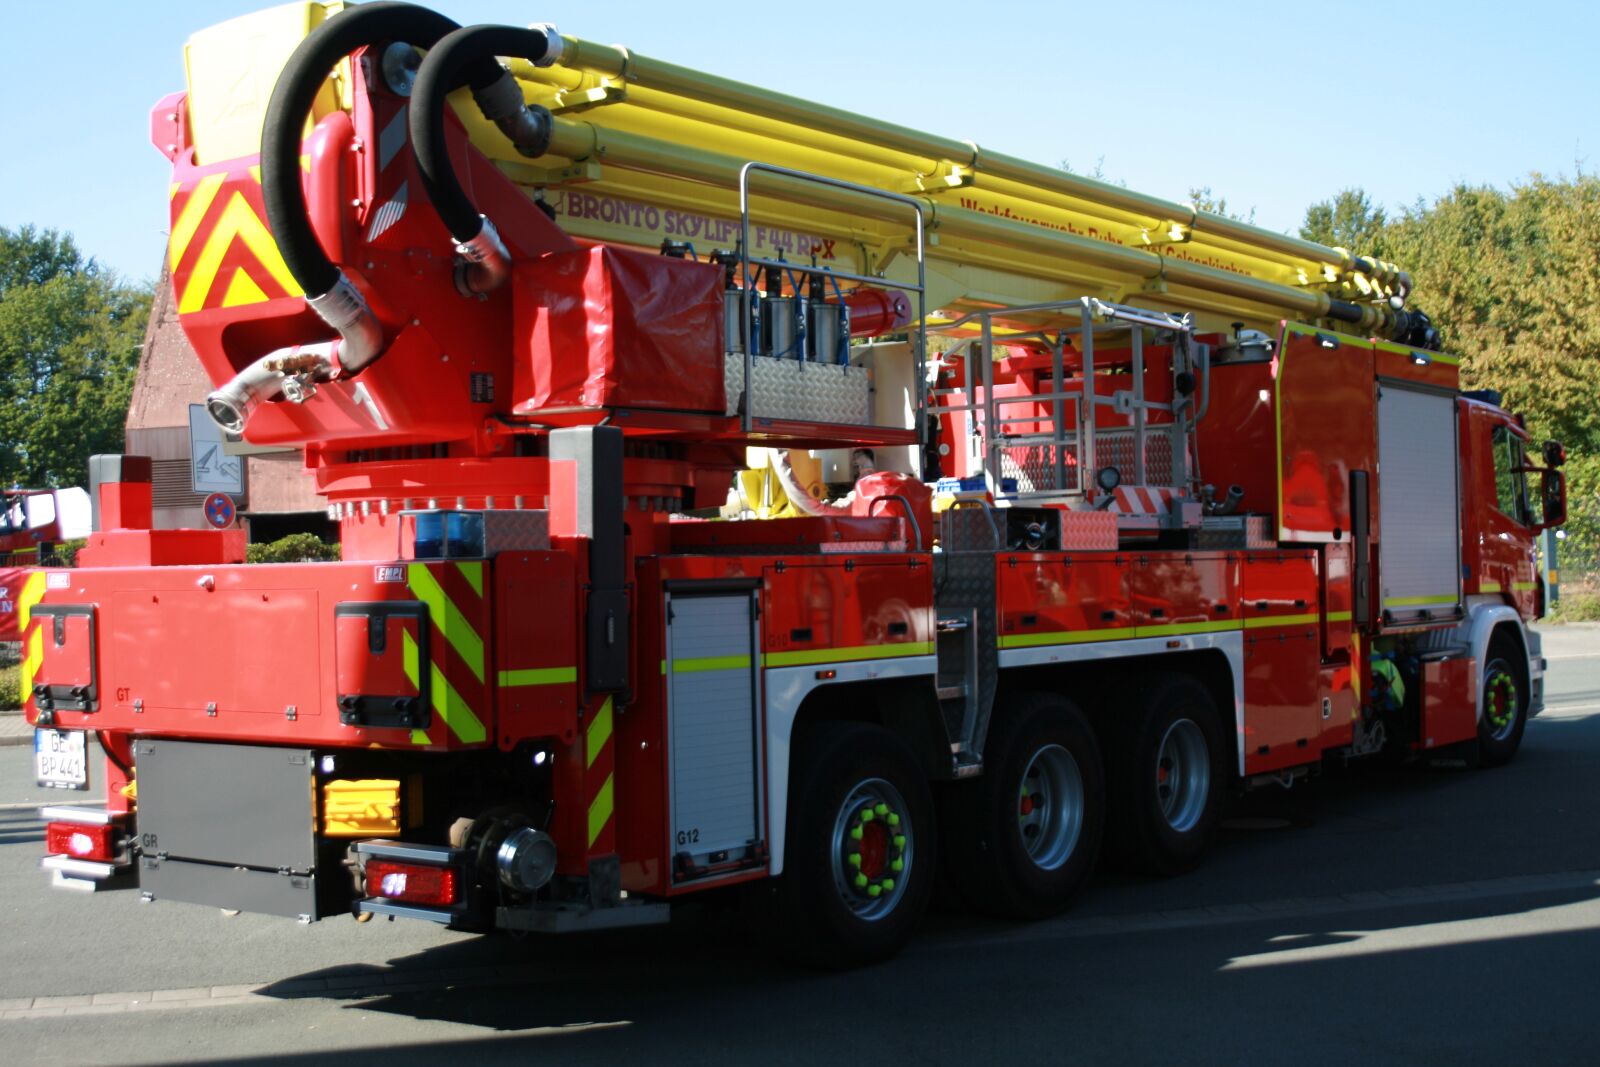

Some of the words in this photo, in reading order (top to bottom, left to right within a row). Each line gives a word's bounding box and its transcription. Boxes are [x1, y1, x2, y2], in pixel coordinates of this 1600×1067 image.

[567, 192, 660, 230] BRONTO
[664, 209, 743, 243] SKYLIFT
[755, 226, 767, 248] F
[353, 382, 389, 430] 1
[378, 567, 403, 580] EMPL
[117, 688, 130, 701] GT
[42, 757, 56, 775] BP
[60, 758, 81, 778] 441
[142, 833, 158, 848] GR
[678, 828, 699, 845] G12
